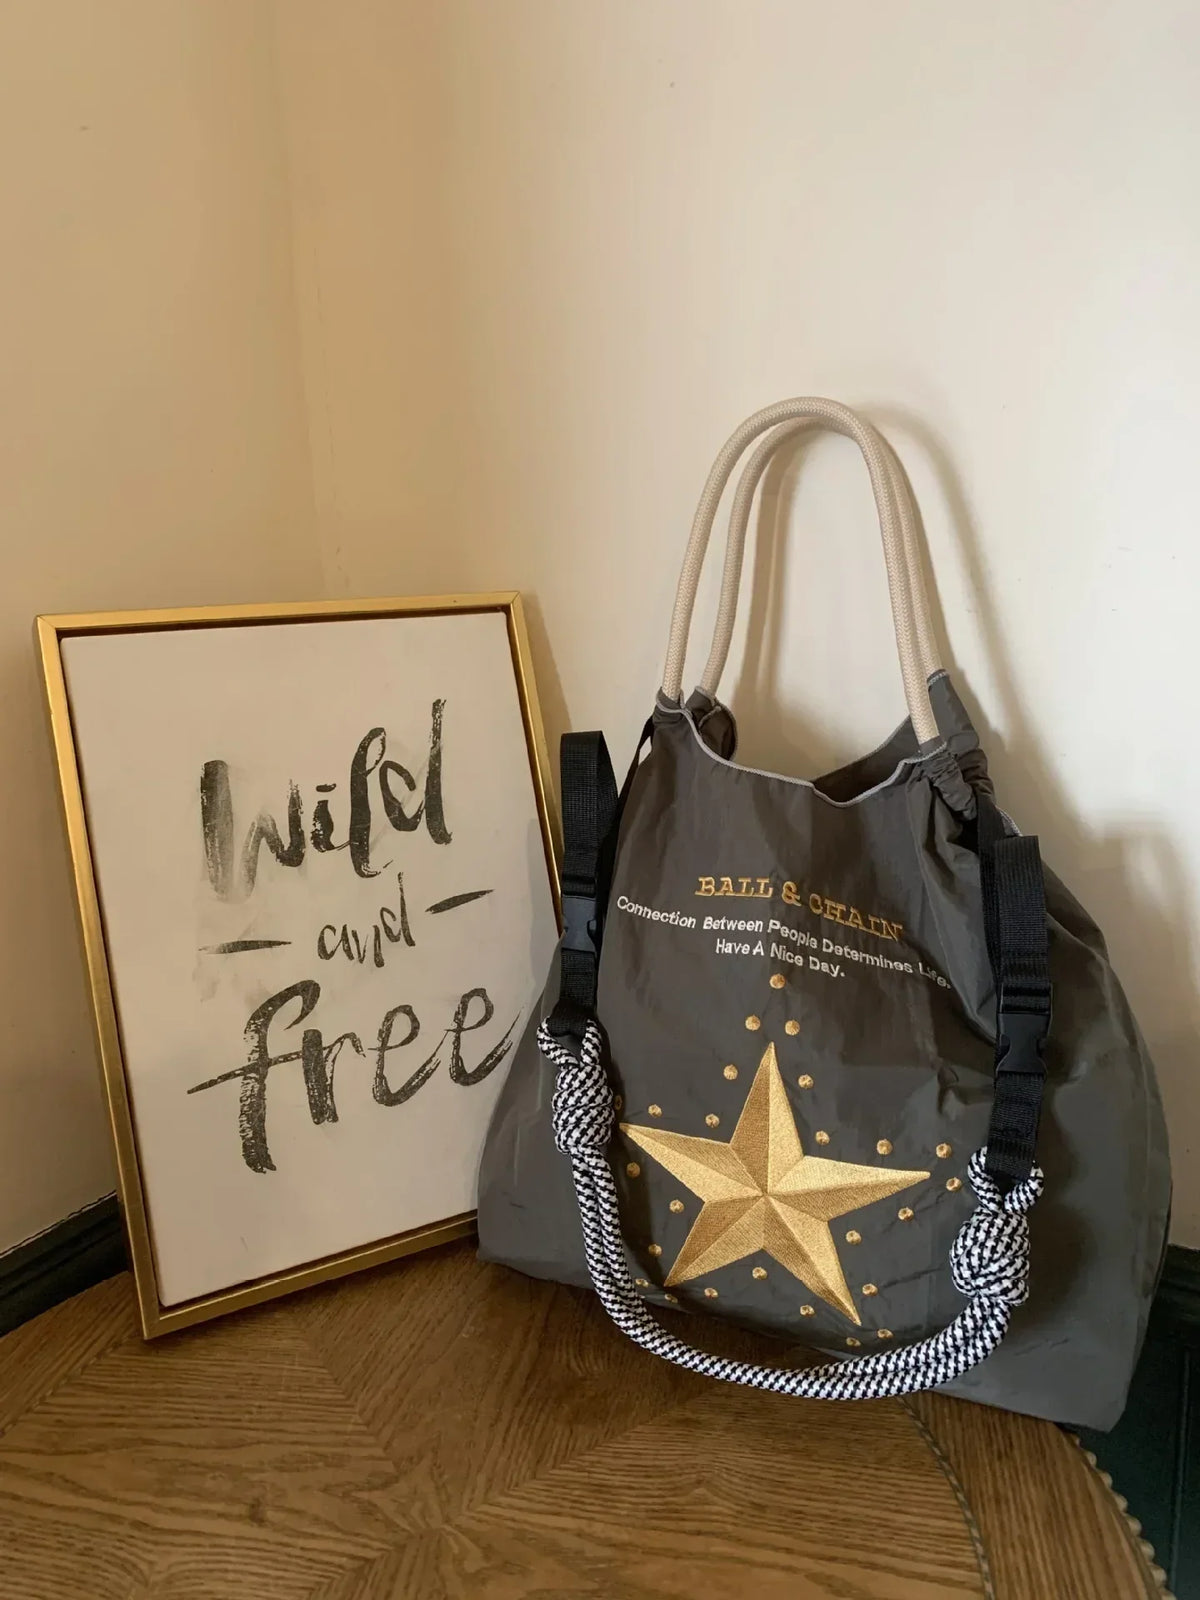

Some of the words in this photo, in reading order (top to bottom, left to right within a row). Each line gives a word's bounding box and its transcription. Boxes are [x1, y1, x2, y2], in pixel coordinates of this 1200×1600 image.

[317, 871, 416, 968] and
[617, 896, 697, 929] Connection
[703, 916, 764, 934] Between
[767, 919, 818, 949] People
[822, 938, 913, 974] Determines
[695, 876, 773, 898] BALL
[781, 881, 802, 906] &
[809, 893, 903, 942] CHAIN
[715, 938, 750, 956] Have
[752, 941, 765, 957] A
[770, 943, 803, 967] Nice
[809, 956, 846, 978] Day.
[187, 979, 521, 1173] free
